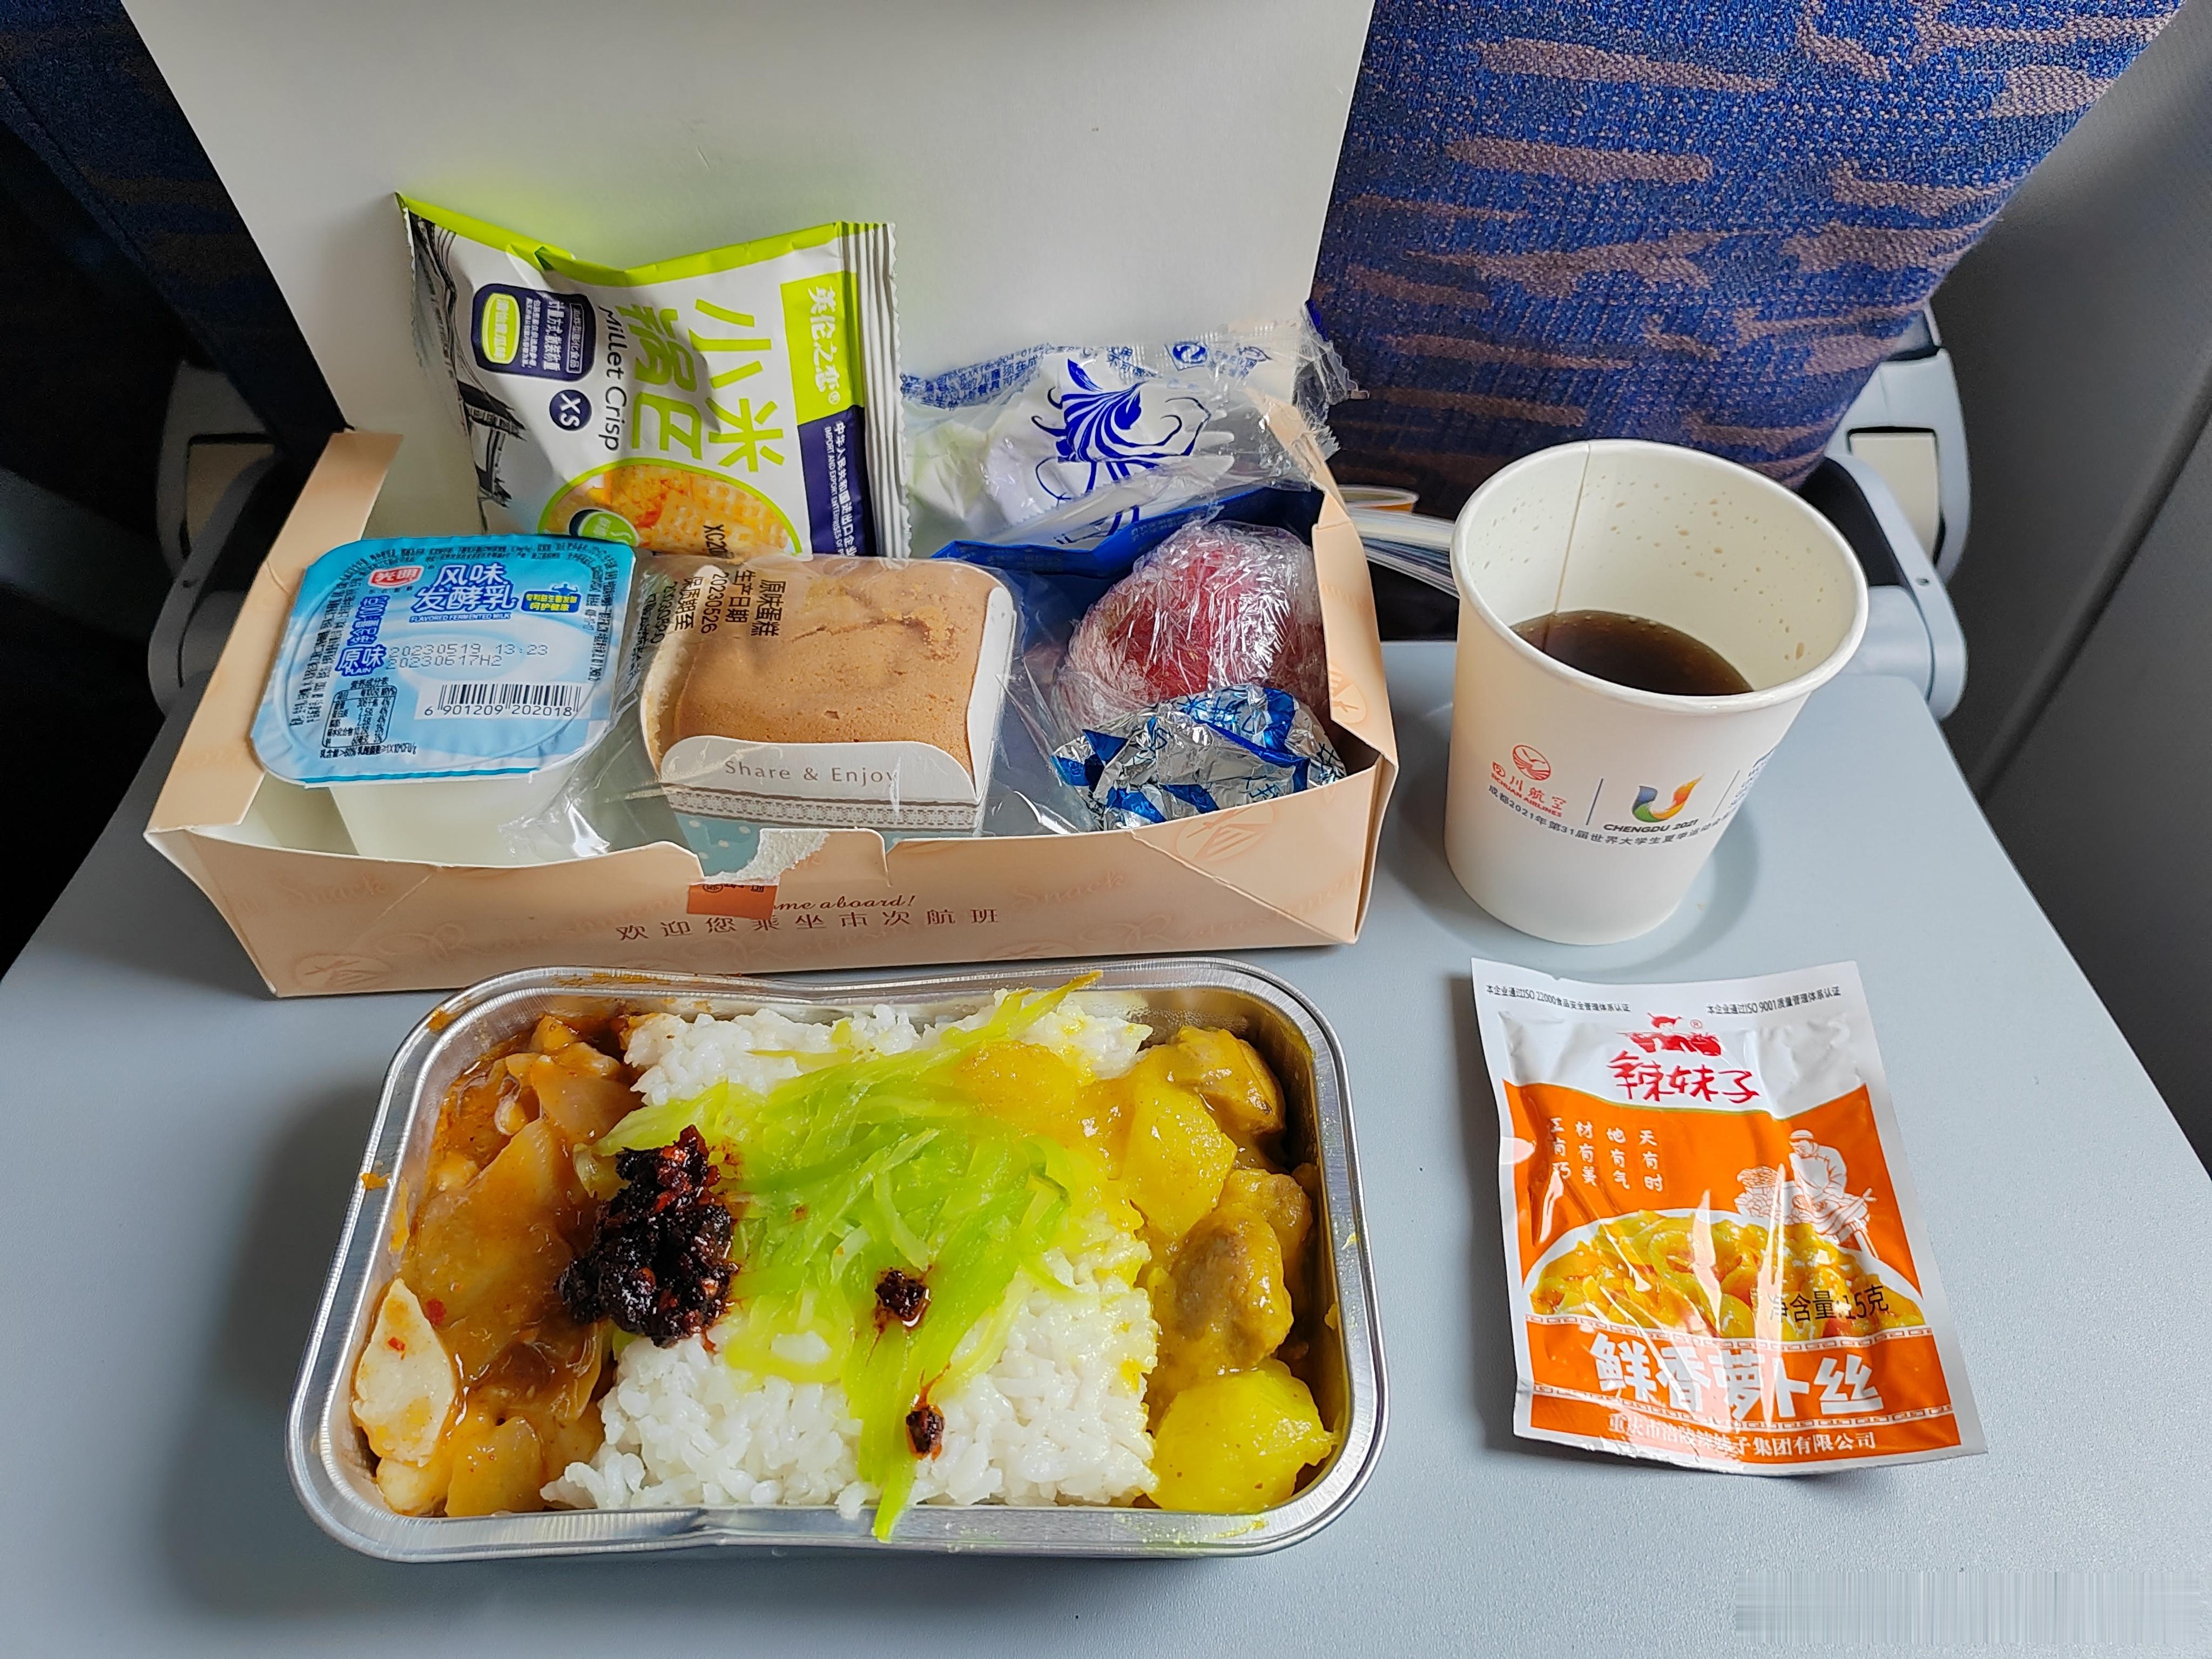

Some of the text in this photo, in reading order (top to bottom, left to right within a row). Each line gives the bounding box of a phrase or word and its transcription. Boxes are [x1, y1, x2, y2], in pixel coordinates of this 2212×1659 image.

[598, 306, 628, 450] Millet Crisp
[616, 304, 703, 460] 锅巴
[689, 299, 785, 472] 小米
[559, 393, 581, 428] XS
[825, 426, 834, 454] IMPORT
[827, 454, 836, 470] AND
[830, 470, 838, 496] EXPORT
[831, 496, 842, 541] ENTERPRISES
[836, 539, 844, 549] OF
[414, 584, 517, 611] 发酵乳
[433, 563, 507, 587] 风味
[725, 570, 756, 623] 生产日期
[411, 614, 448, 622] FLAVORED
[675, 576, 704, 631] 保质期至
[701, 572, 730, 634] 20230526
[750, 579, 786, 637] 原味蛋糕
[338, 646, 384, 671] 原味
[386, 655, 503, 670] 20230617H2
[388, 644, 548, 658] 20230519 13:23
[424, 705, 572, 717] 6 901209 202018
[725, 760, 791, 780] Share
[804, 767, 818, 781] &
[1488, 785, 1730, 845] 成都2021年第31届世界大学生夏季运动会
[1491, 772, 1562, 818] SICHUAN AIRLINES
[1603, 818, 1699, 833] CHENGDU 2021
[820, 895, 918, 910] aboard!
[1607, 1050, 1759, 1103] 辣妹子
[1550, 1117, 1572, 1180] 工有巧
[1575, 1121, 1597, 1186] 材有美
[1606, 1127, 1630, 1190] 地有气
[1638, 1129, 1663, 1192] 天有时
[1588, 1331, 1884, 1420] 鲜香萝卜丝
